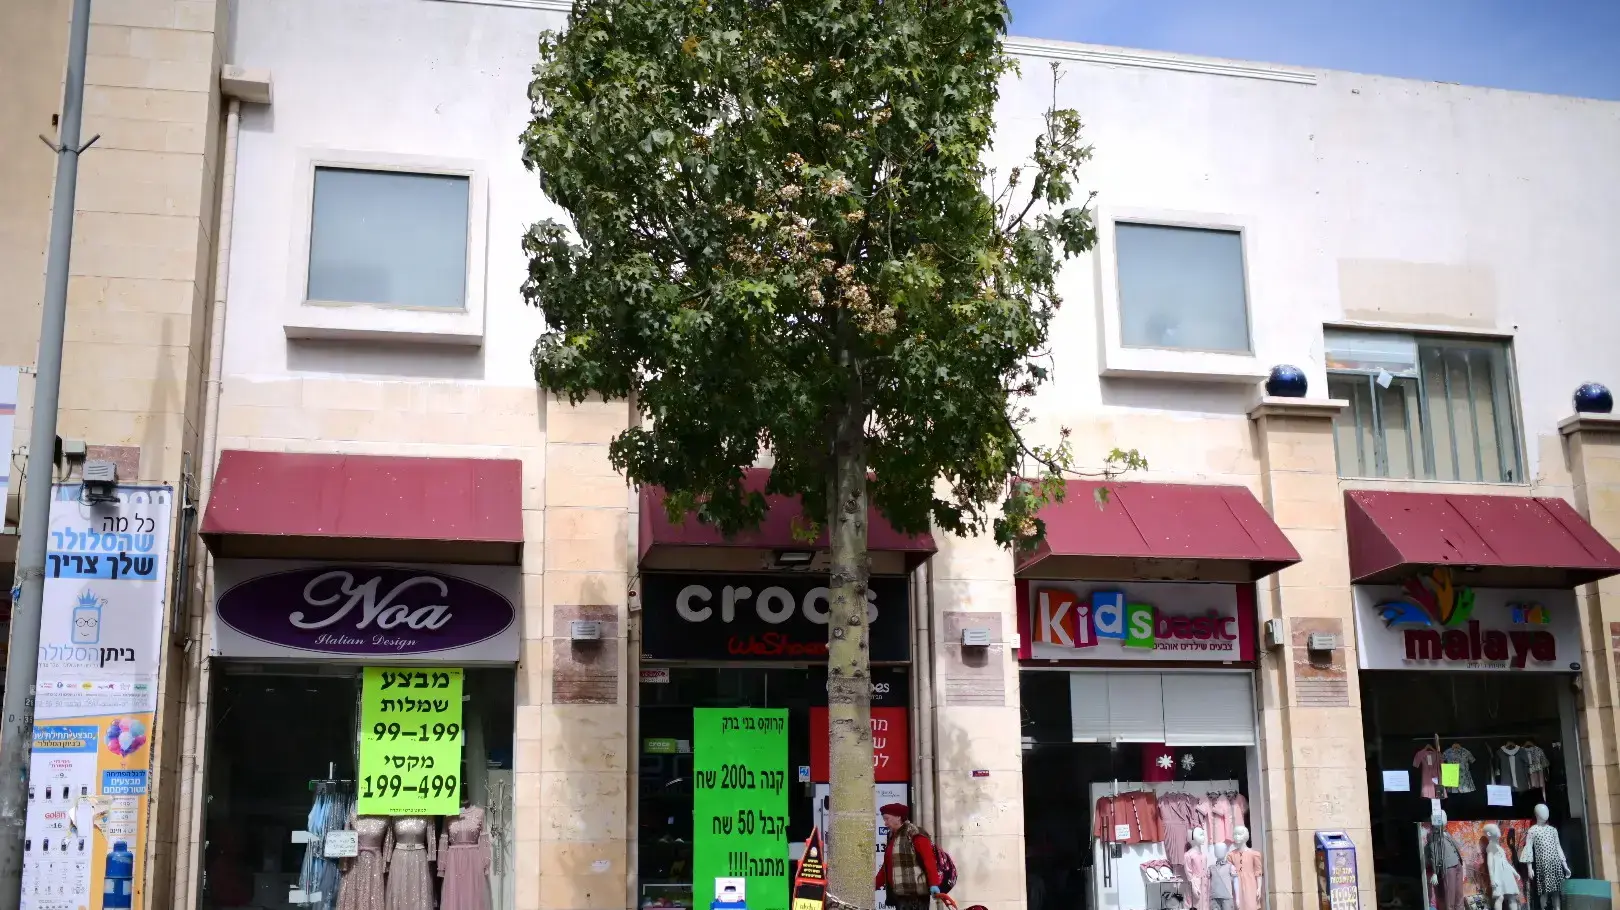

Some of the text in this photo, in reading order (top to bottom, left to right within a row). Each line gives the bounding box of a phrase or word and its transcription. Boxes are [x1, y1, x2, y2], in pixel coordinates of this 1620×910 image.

[103, 513, 155, 533] כל מה
[51, 527, 155, 552] שהסלולר
[48, 552, 154, 579] שלך צריך
[289, 570, 452, 630] Noa
[1039, 591, 1237, 646] Kids basic
[314, 633, 418, 650] Italian Design
[1209, 642, 1233, 651] צבעים
[1403, 619, 1557, 668] malaya
[380, 671, 450, 691] מבצע
[380, 696, 449, 713] שמלות
[373, 722, 460, 742] 99-199
[722, 717, 784, 735] קרוקס בני ברק
[383, 754, 435, 773] מקסי
[362, 774, 457, 799] 199-499
[696, 764, 784, 796] קנה ב200 שח
[712, 810, 785, 841] קבל 50 שח
[728, 852, 785, 877] מתנה!!!!
